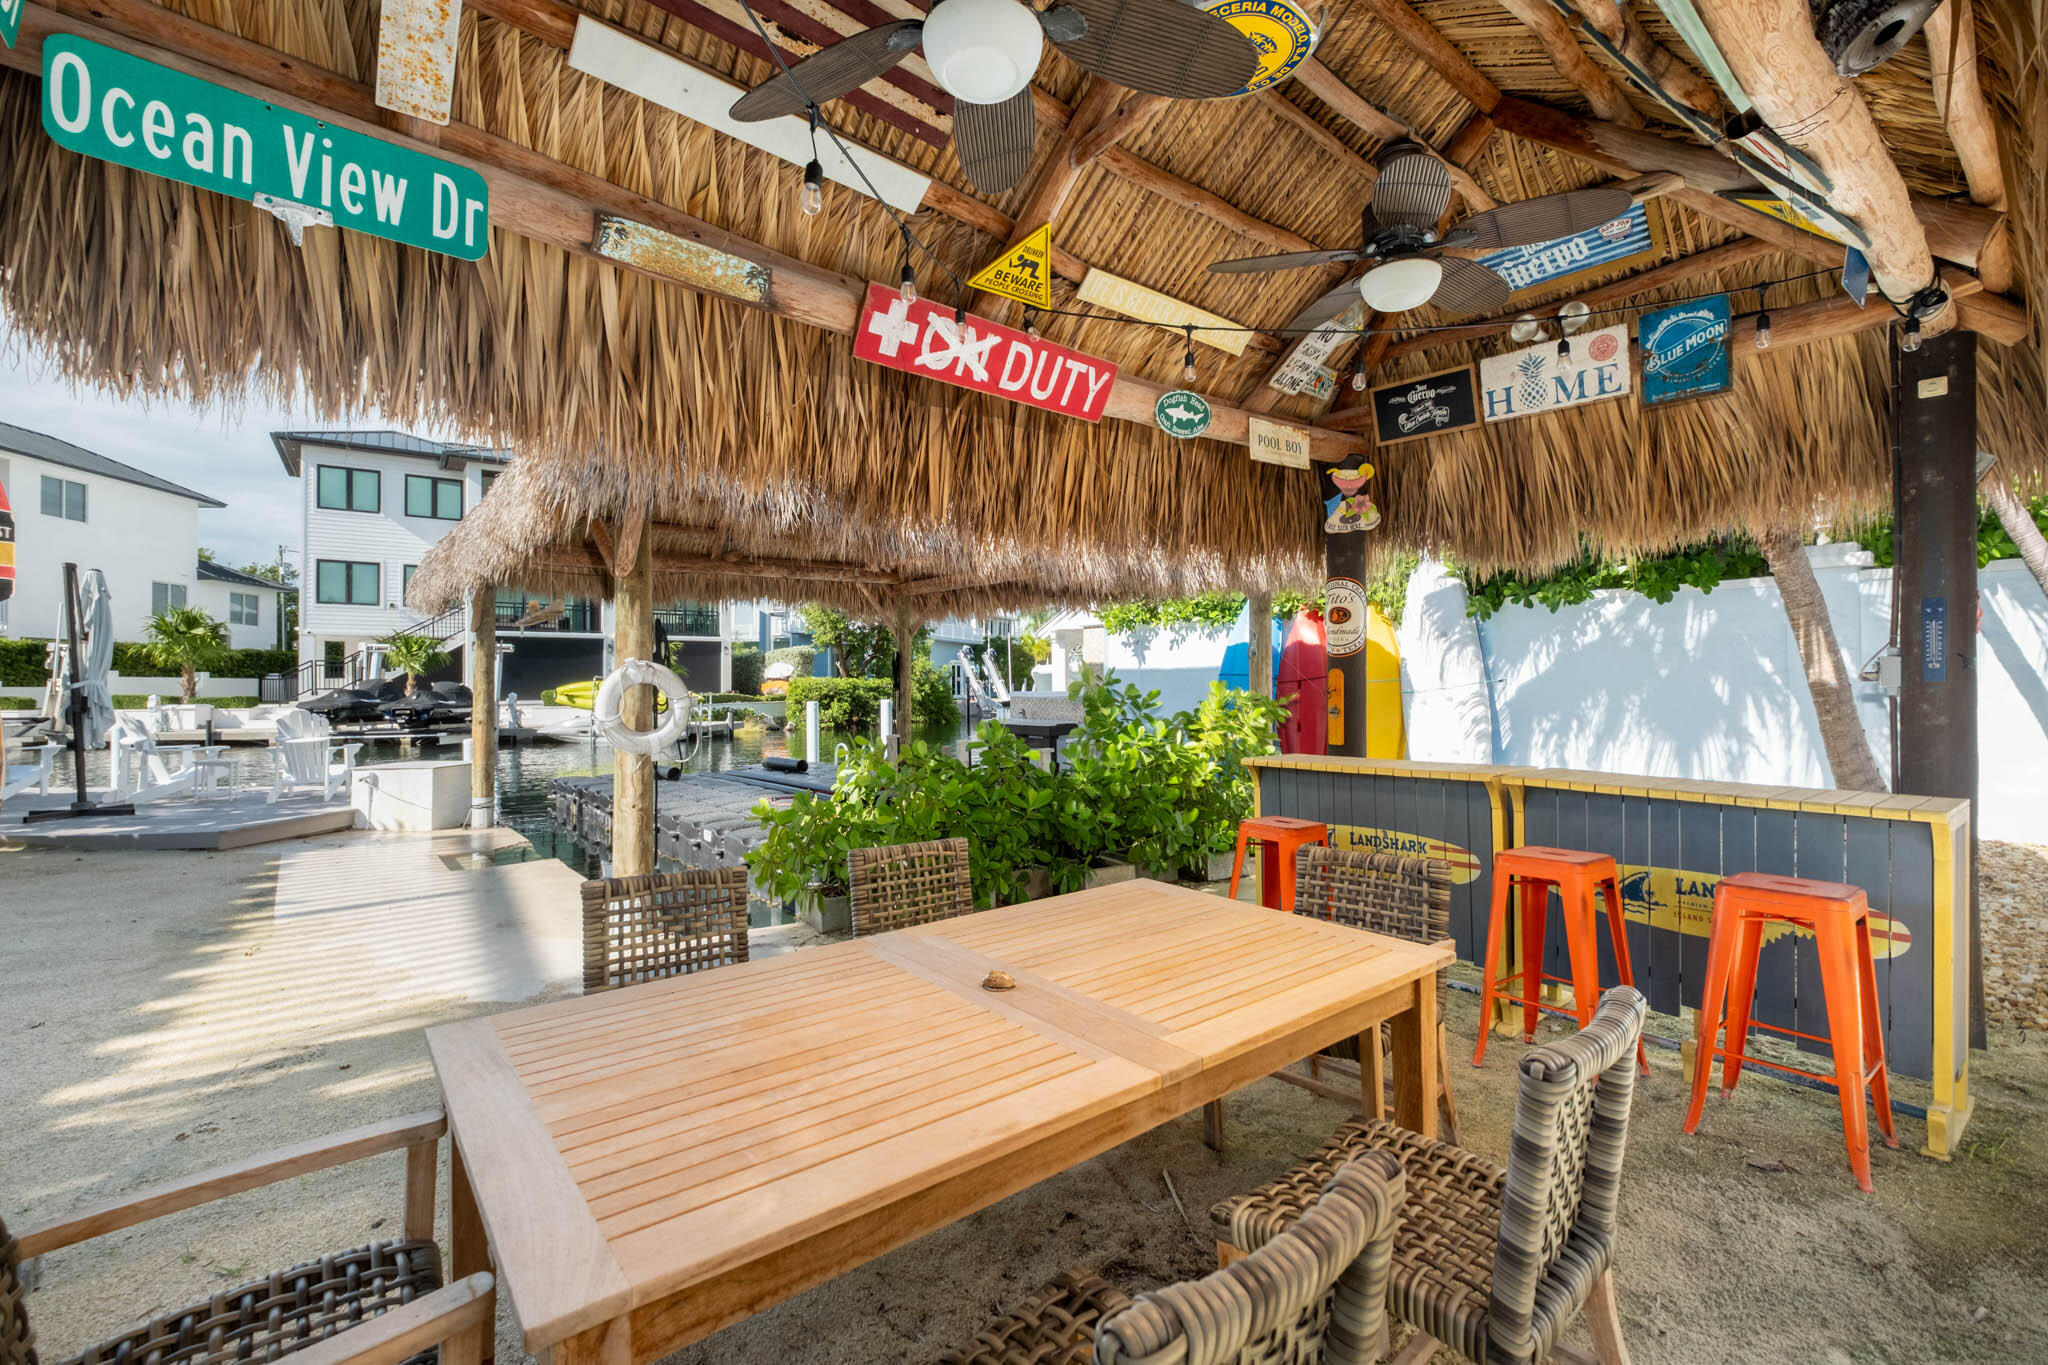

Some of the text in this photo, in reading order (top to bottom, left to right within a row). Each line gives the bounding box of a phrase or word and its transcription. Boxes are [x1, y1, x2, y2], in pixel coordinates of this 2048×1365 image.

[1272, 66, 1291, 79] DE
[48, 50, 485, 248] Ocean View Dr
[1022, 245, 1045, 259] DRUNKEN
[984, 277, 1043, 300] PEOPLE CROSSING
[993, 269, 1044, 293] BEWARE
[1317, 325, 1337, 344] NO
[1646, 344, 1684, 372] BLUE
[1685, 322, 1725, 352] MOON
[998, 340, 1111, 413] DUTY
[1272, 371, 1303, 392] ALONE
[1163, 394, 1205, 412] Dogfish Head
[1407, 388, 1436, 404] Cuervo
[1258, 433, 1305, 455] POOL BOY
[1350, 831, 1428, 854] LANDSHARK
